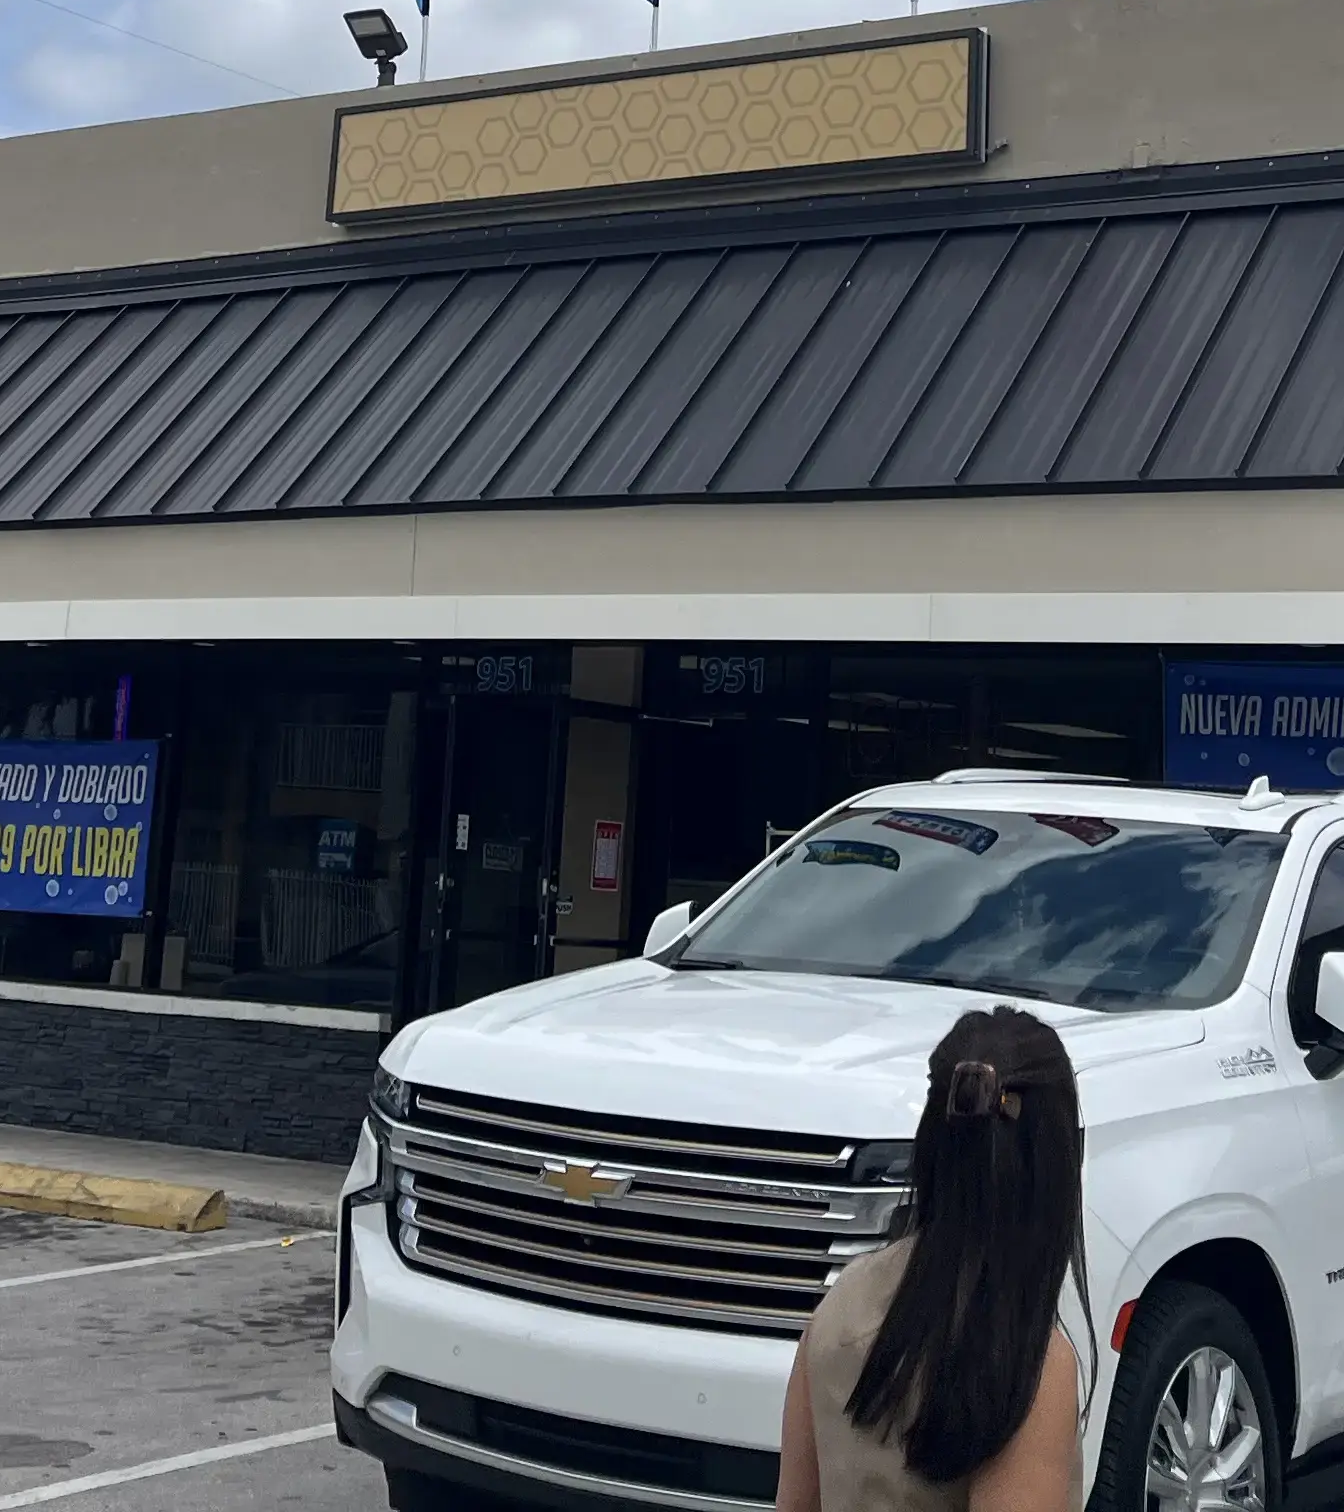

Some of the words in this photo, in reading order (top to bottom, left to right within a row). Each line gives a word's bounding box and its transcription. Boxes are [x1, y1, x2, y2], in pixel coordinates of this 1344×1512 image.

[476, 656, 534, 692] 951
[703, 656, 765, 694] 951
[1179, 693, 1263, 737] NUEVA
[43, 764, 56, 803] Y
[57, 764, 148, 804] DOBLADO
[19, 824, 67, 876] POR
[71, 826, 140, 879] LIBRA
[317, 830, 356, 847] ATM
